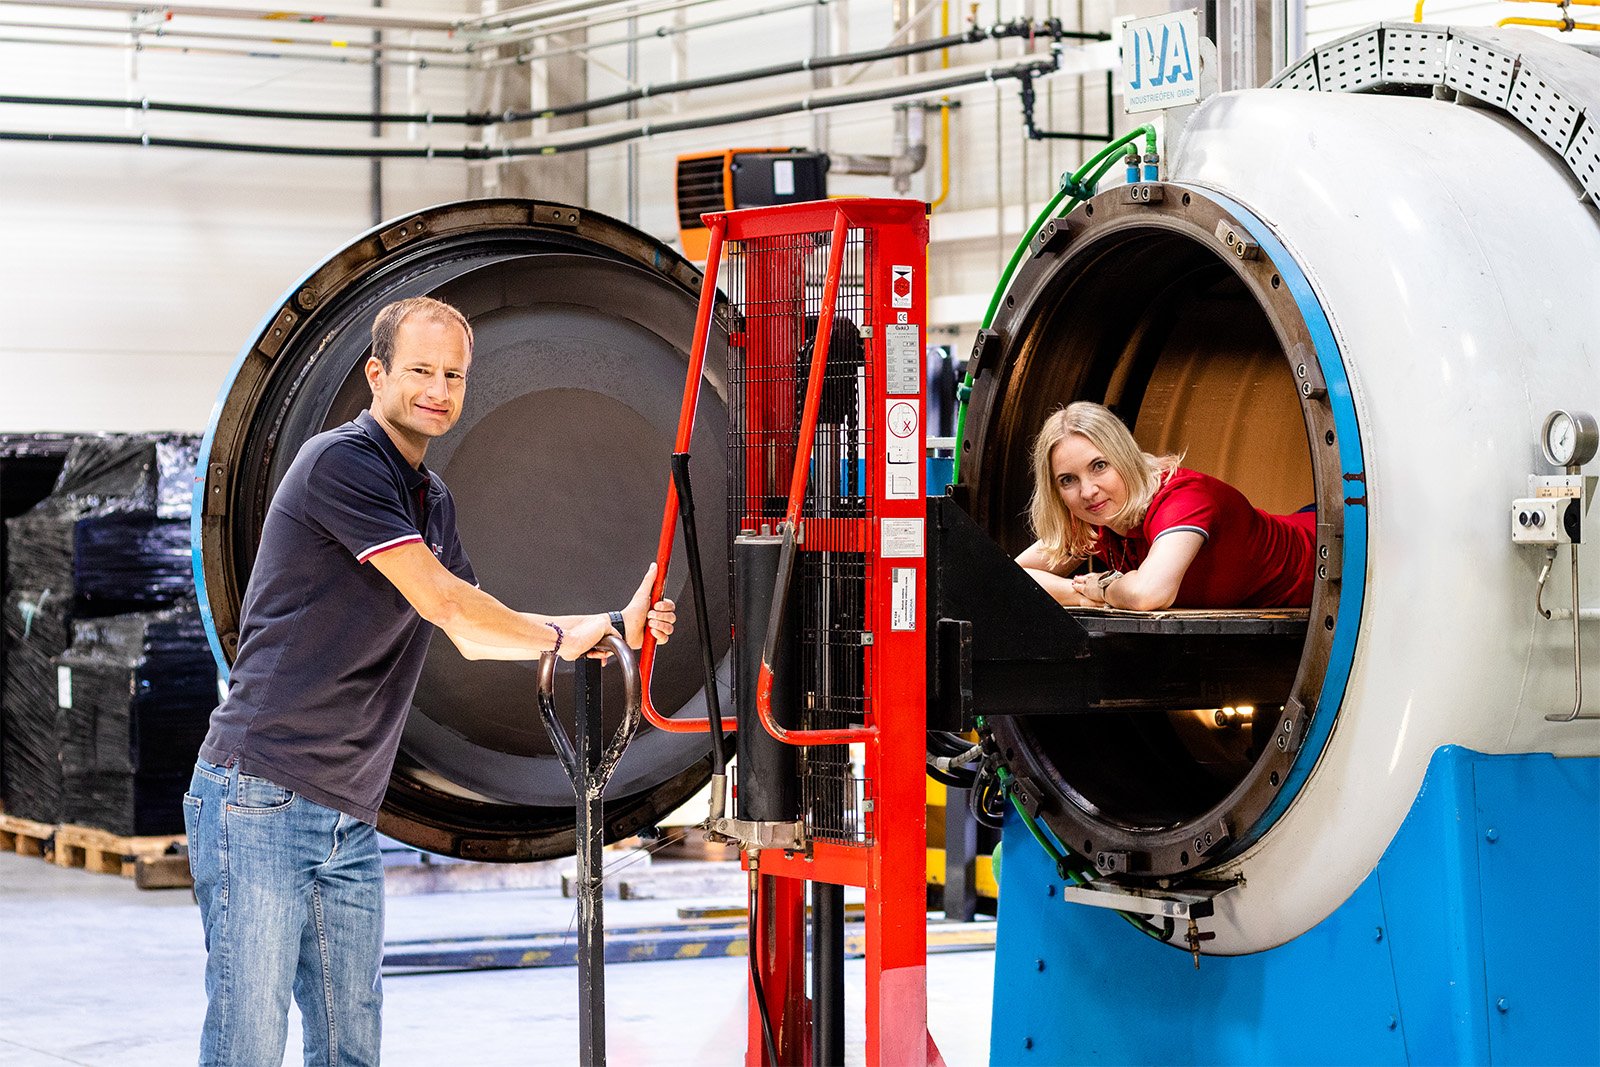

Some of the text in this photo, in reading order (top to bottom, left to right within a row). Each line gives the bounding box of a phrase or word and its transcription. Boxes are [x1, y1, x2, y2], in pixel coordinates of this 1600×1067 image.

[1128, 21, 1193, 89] IVA
[1130, 88, 1194, 105] INDUSTRIEÖFEN GMBH
